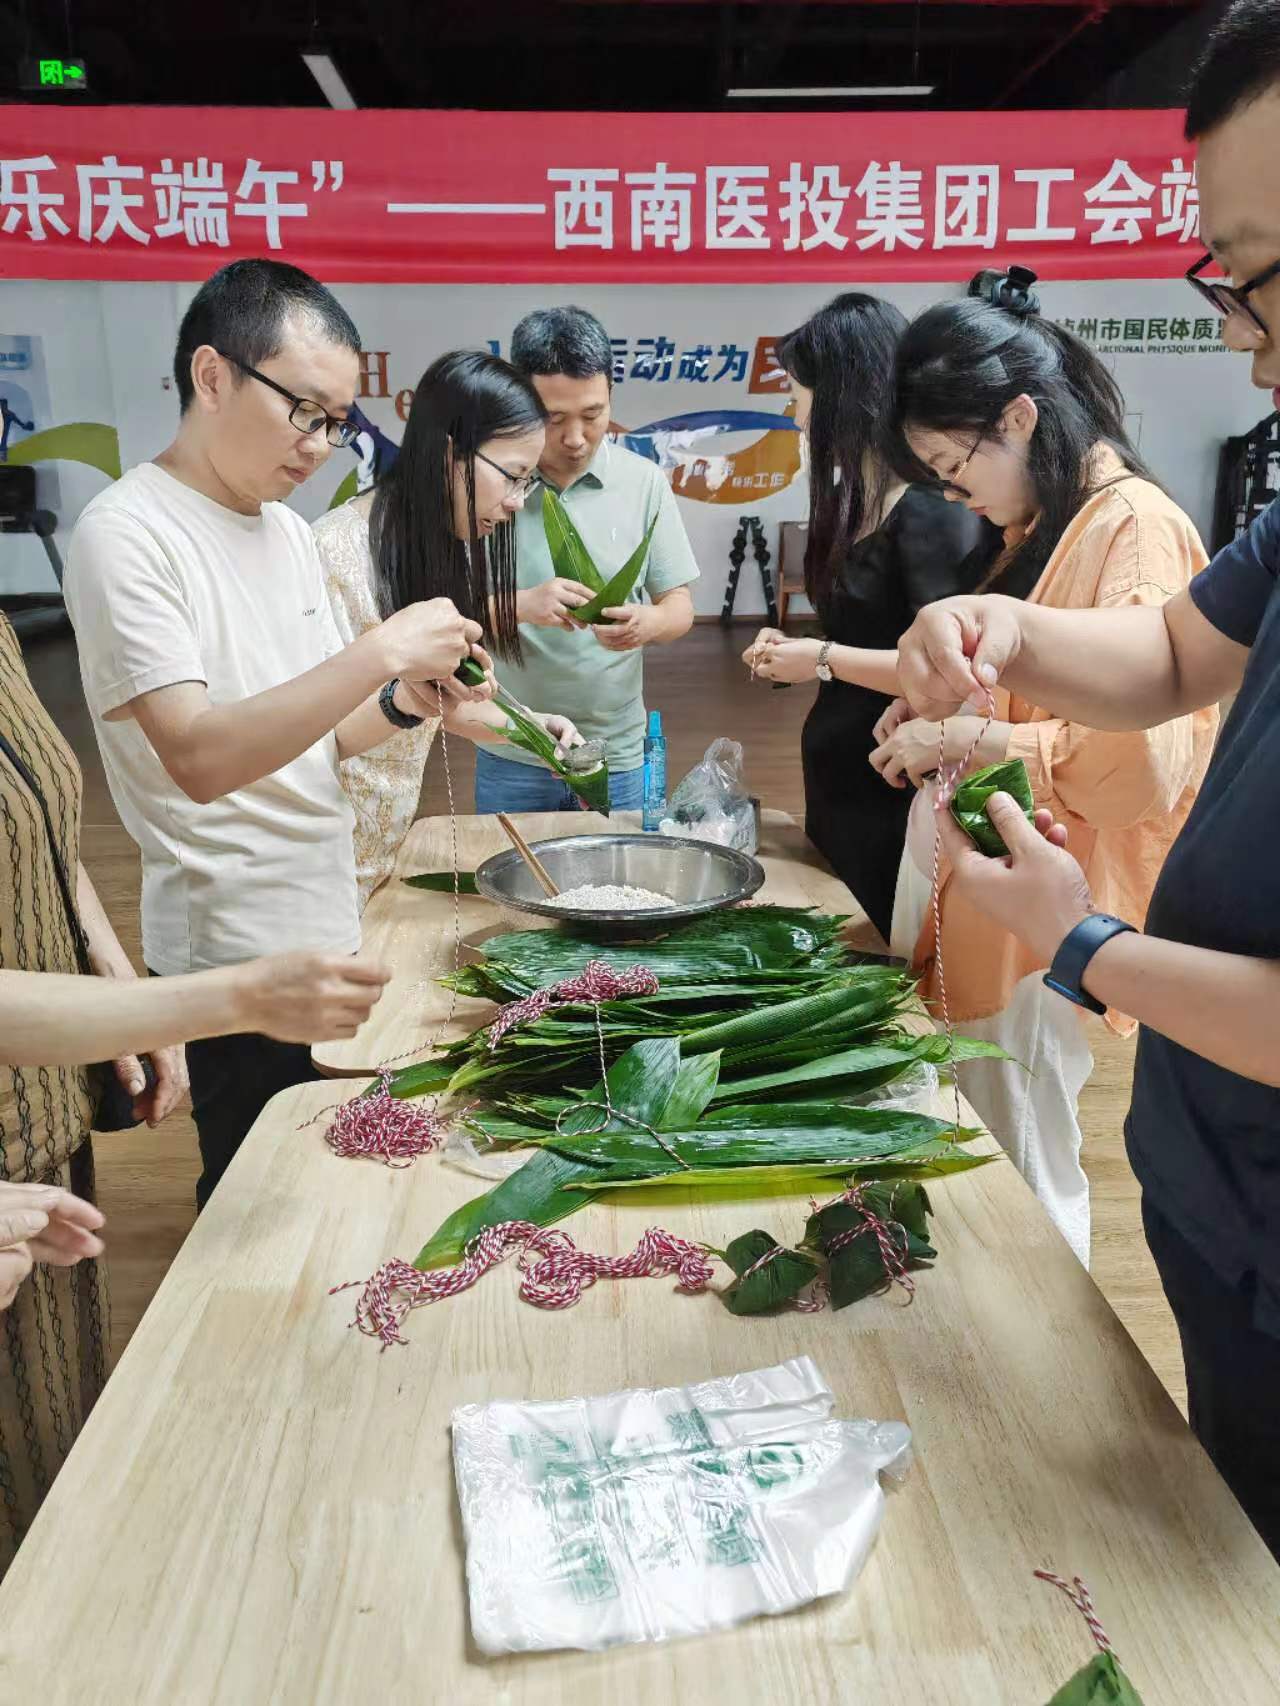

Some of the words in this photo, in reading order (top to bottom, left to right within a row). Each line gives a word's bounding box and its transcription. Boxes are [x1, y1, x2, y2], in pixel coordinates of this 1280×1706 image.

[1056, 318, 1223, 341] 州市国民体质
